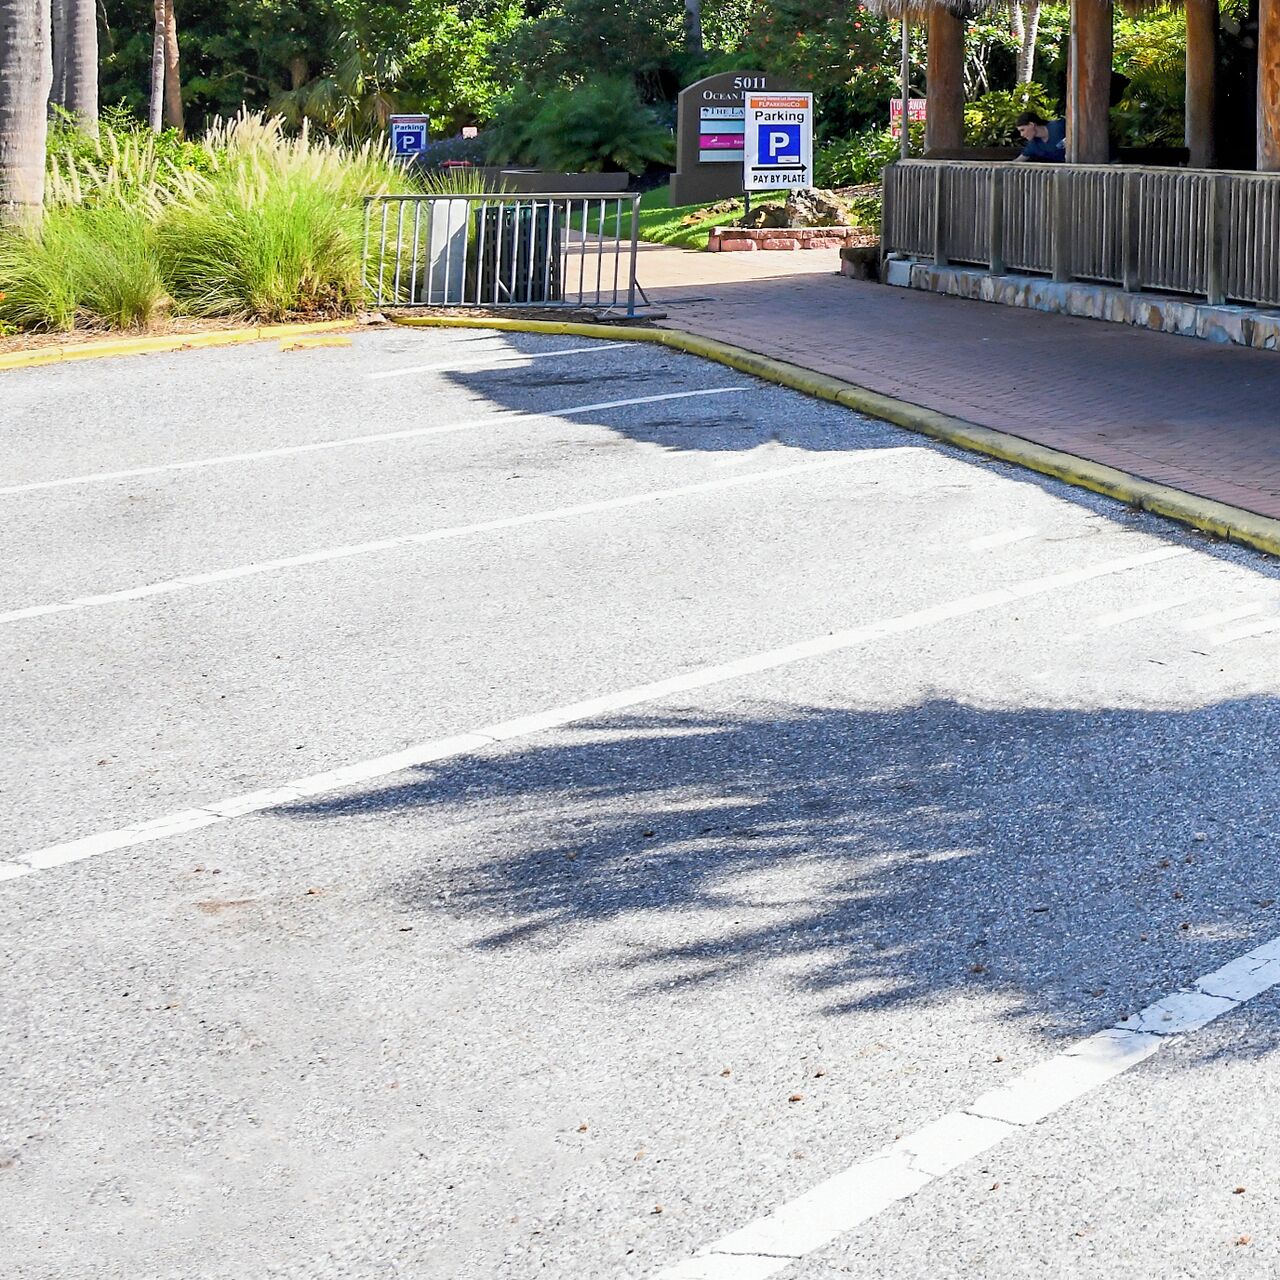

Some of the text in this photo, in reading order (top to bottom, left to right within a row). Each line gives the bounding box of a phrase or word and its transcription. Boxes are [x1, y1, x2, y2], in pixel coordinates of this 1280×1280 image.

[734, 77, 766, 89] 5011
[755, 111, 804, 123] Parking
[769, 132, 789, 157] P
[753, 174, 805, 183] PAY BY PLATE
